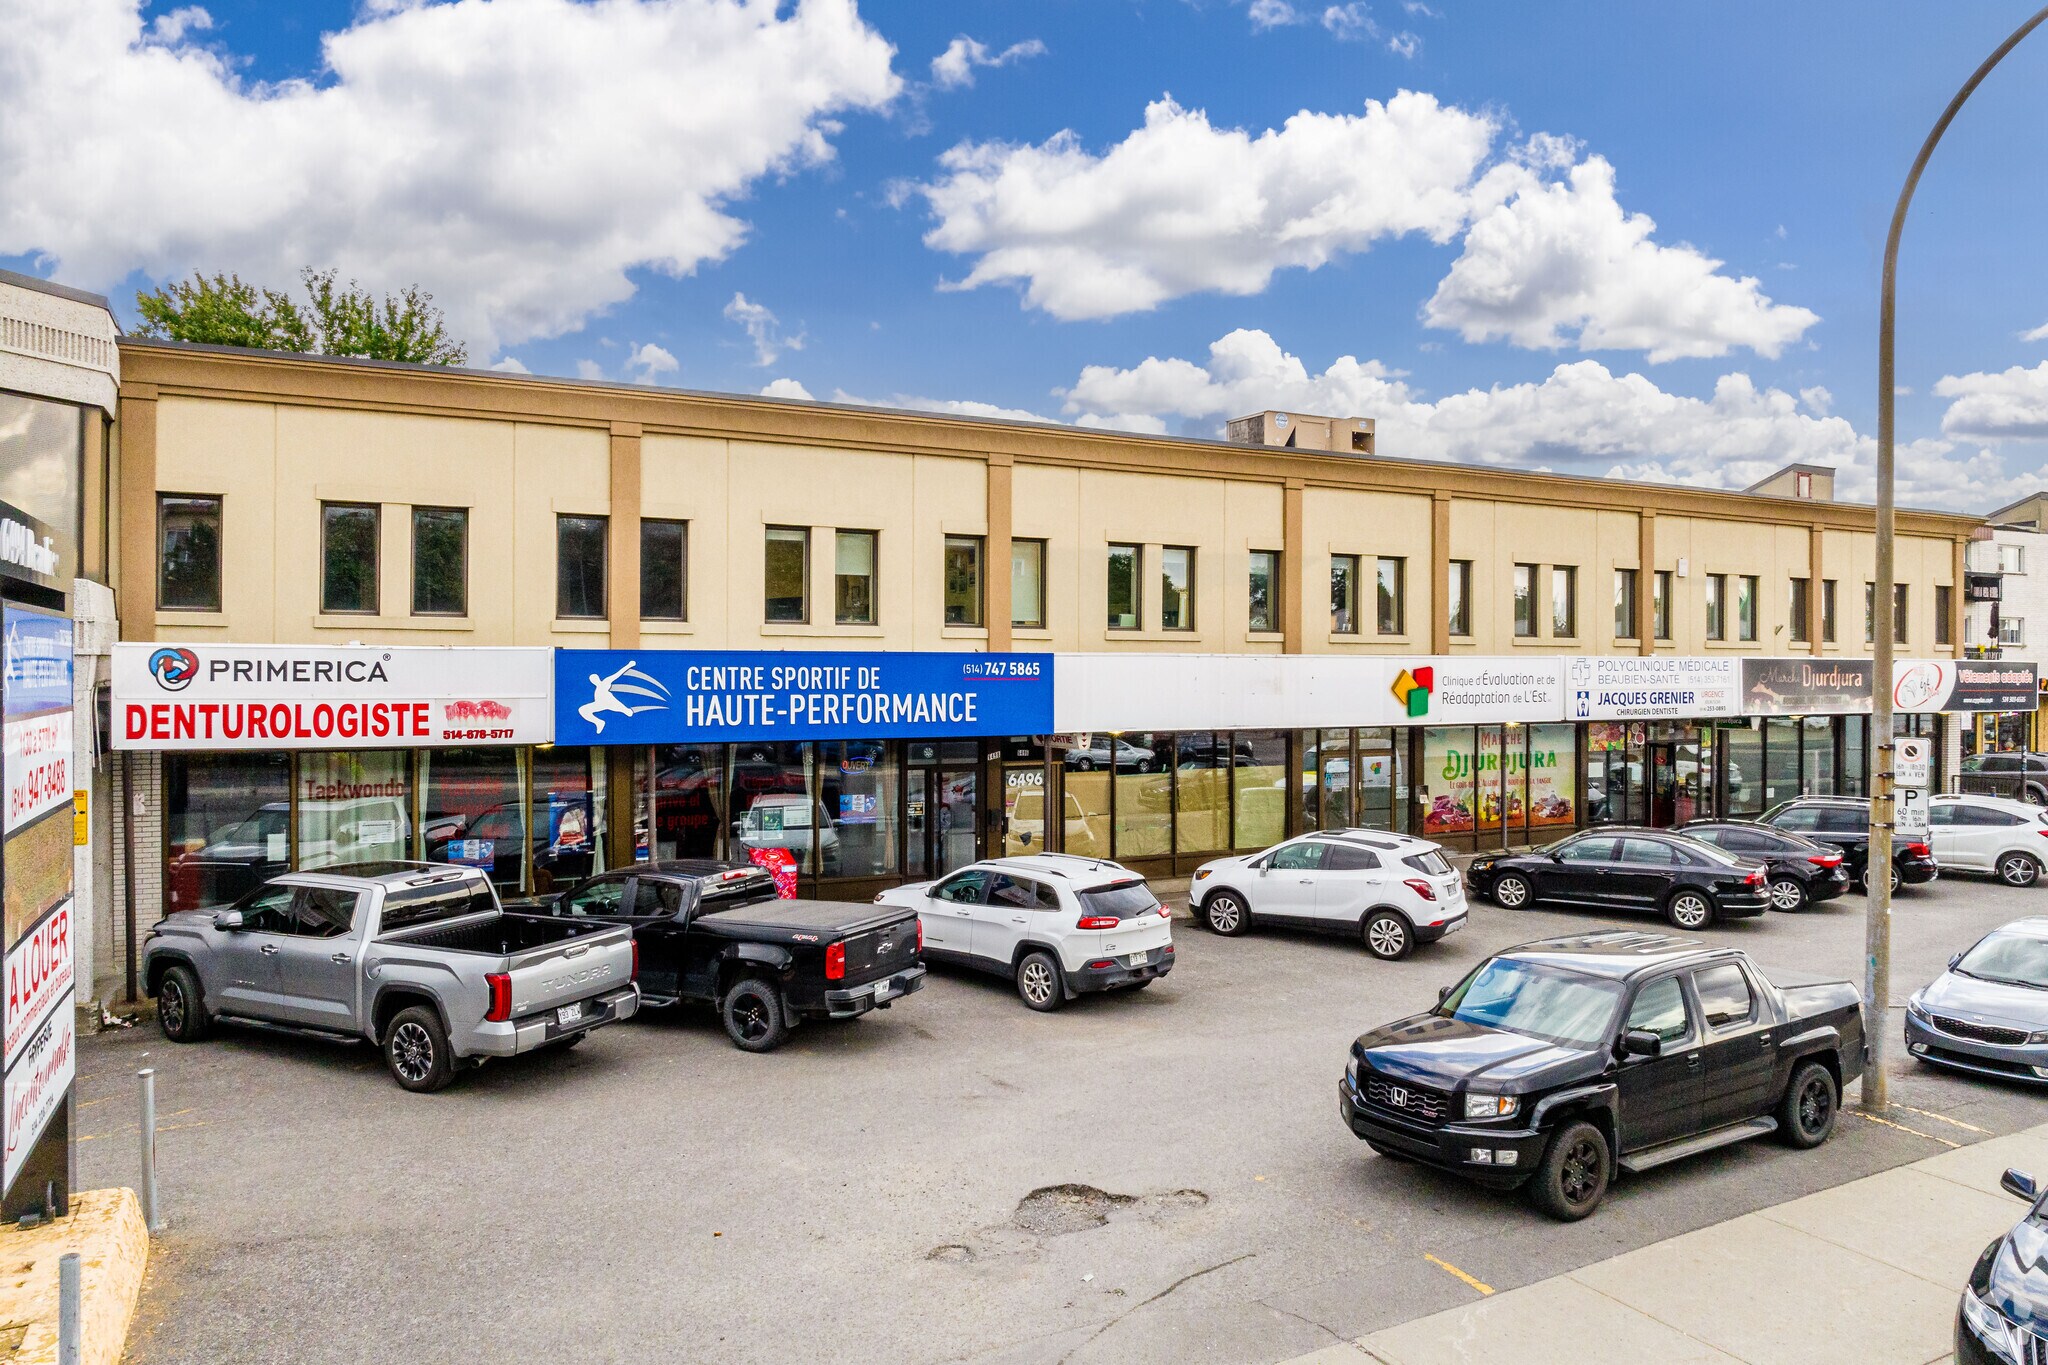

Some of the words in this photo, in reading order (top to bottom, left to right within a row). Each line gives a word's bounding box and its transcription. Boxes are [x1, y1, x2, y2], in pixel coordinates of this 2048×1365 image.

[963, 664, 983, 675] (514)
[984, 662, 1007, 676] 747
[1009, 662, 1040, 676] 5865
[1598, 660, 1676, 672] POLYCLINIQUE
[1679, 658, 1729, 672] MÉDICALE
[687, 666, 764, 690] CENTRE
[771, 666, 851, 690] SPORTIF
[858, 666, 880, 690] DE
[1442, 675, 1474, 688] Clinique
[1536, 675, 1544, 685] et
[1546, 675, 1555, 685] de
[1803, 664, 1862, 690] Djurdjura
[1442, 690, 1510, 706] Réadaptation
[1513, 694, 1522, 703] de
[1524, 690, 1547, 703] L'Est
[1597, 692, 1647, 706] JACQUES
[1650, 691, 1694, 705] GRENIER
[687, 692, 978, 727] HAUTE-PERFORMANCE
[1616, 708, 1651, 716] CHIRURGIEN
[1652, 707, 1679, 715] DENTISTE
[126, 703, 430, 739] DENTUROLOGISTE
[1051, 735, 1073, 744] ORTIE
[842, 760, 870, 770] OUVERT
[1008, 773, 1042, 786] 6496
[306, 778, 404, 799] Taekwondo
[1905, 790, 1918, 806] P
[1897, 807, 1907, 815] 60
[23, 909, 69, 1006] LOUER
[541, 963, 611, 992] TUNDRA
